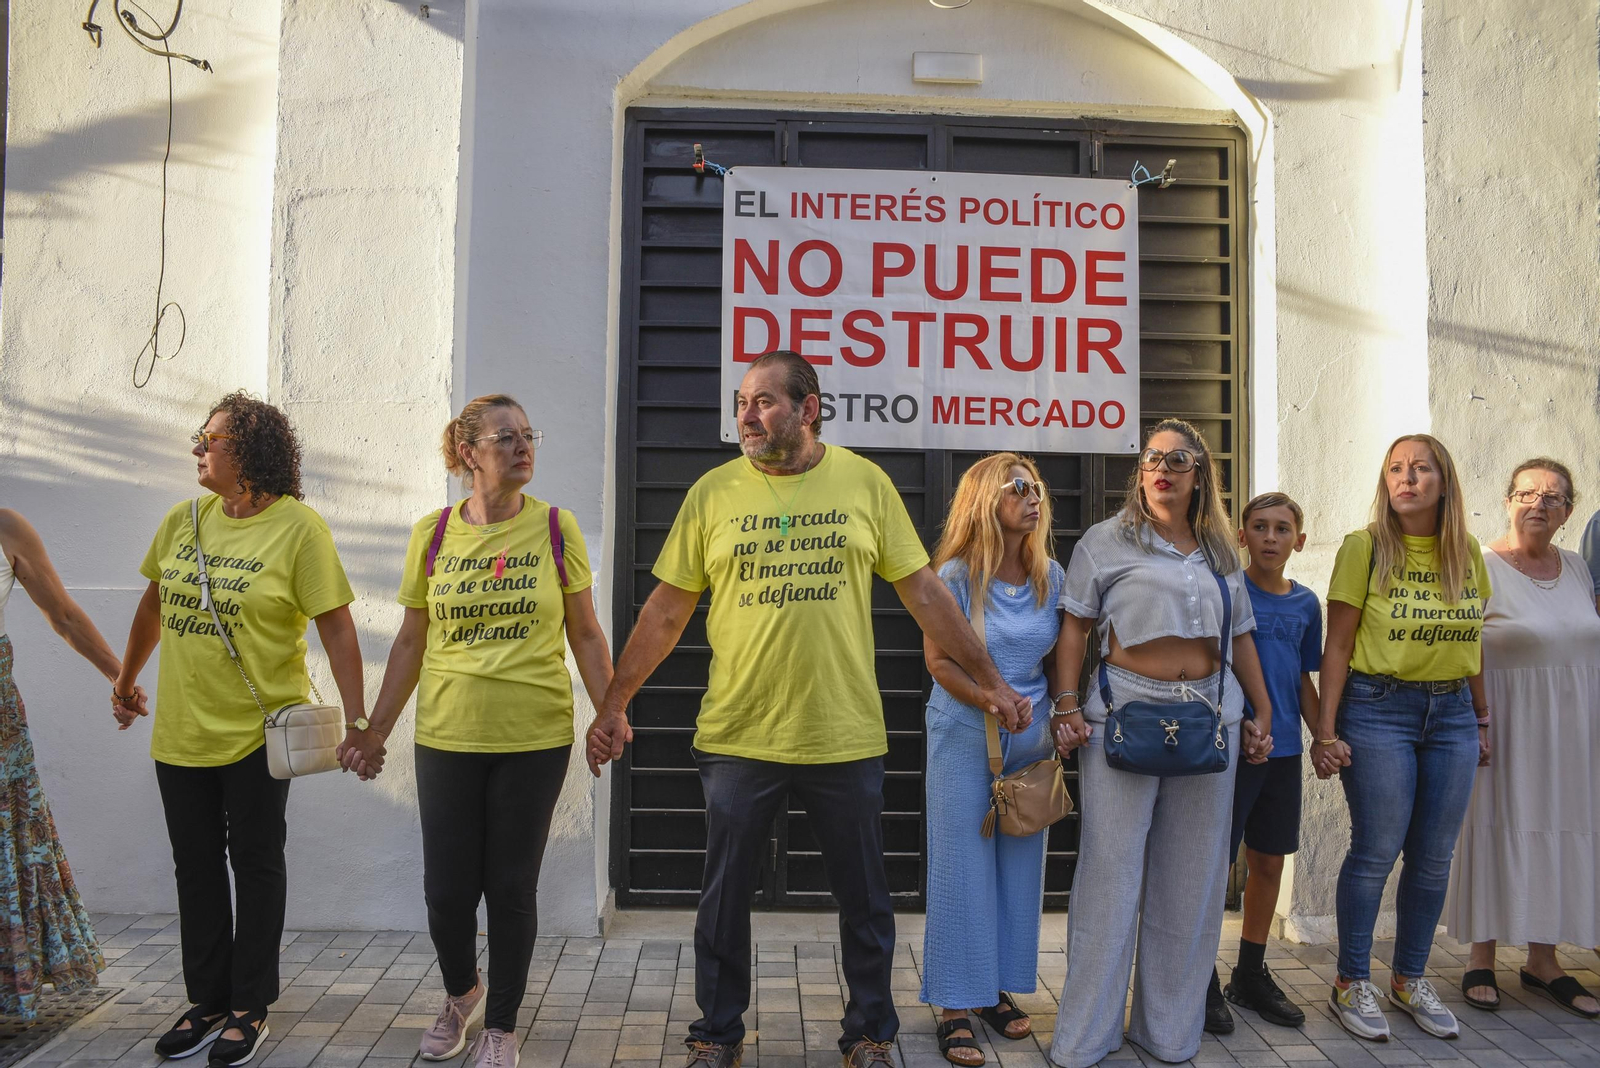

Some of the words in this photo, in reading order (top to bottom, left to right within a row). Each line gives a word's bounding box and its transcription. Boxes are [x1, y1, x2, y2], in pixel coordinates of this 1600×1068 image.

[735, 190, 779, 217] EL
[791, 188, 947, 223] INTERÉS
[960, 193, 1126, 230] POLÍTICO
[733, 238, 843, 298] NO
[872, 242, 1127, 306] PUEDE
[732, 306, 1126, 375] DESTRUIR
[932, 396, 1126, 430] MERCADO
[762, 509, 849, 530] mercado
[733, 541, 758, 557] no
[764, 540, 785, 553] se
[790, 531, 847, 552] vende
[162, 569, 180, 580] no
[739, 561, 755, 582] El
[759, 556, 845, 579] mercado
[433, 583, 453, 597] no
[456, 581, 476, 594] se
[482, 574, 537, 592] vende
[1388, 587, 1409, 599] no
[1413, 589, 1431, 601] se
[435, 602, 448, 620] El
[450, 596, 538, 620] mercado
[739, 592, 754, 608] se
[1391, 602, 1408, 619] El
[1412, 605, 1483, 620] mercado
[1388, 629, 1406, 641] se
